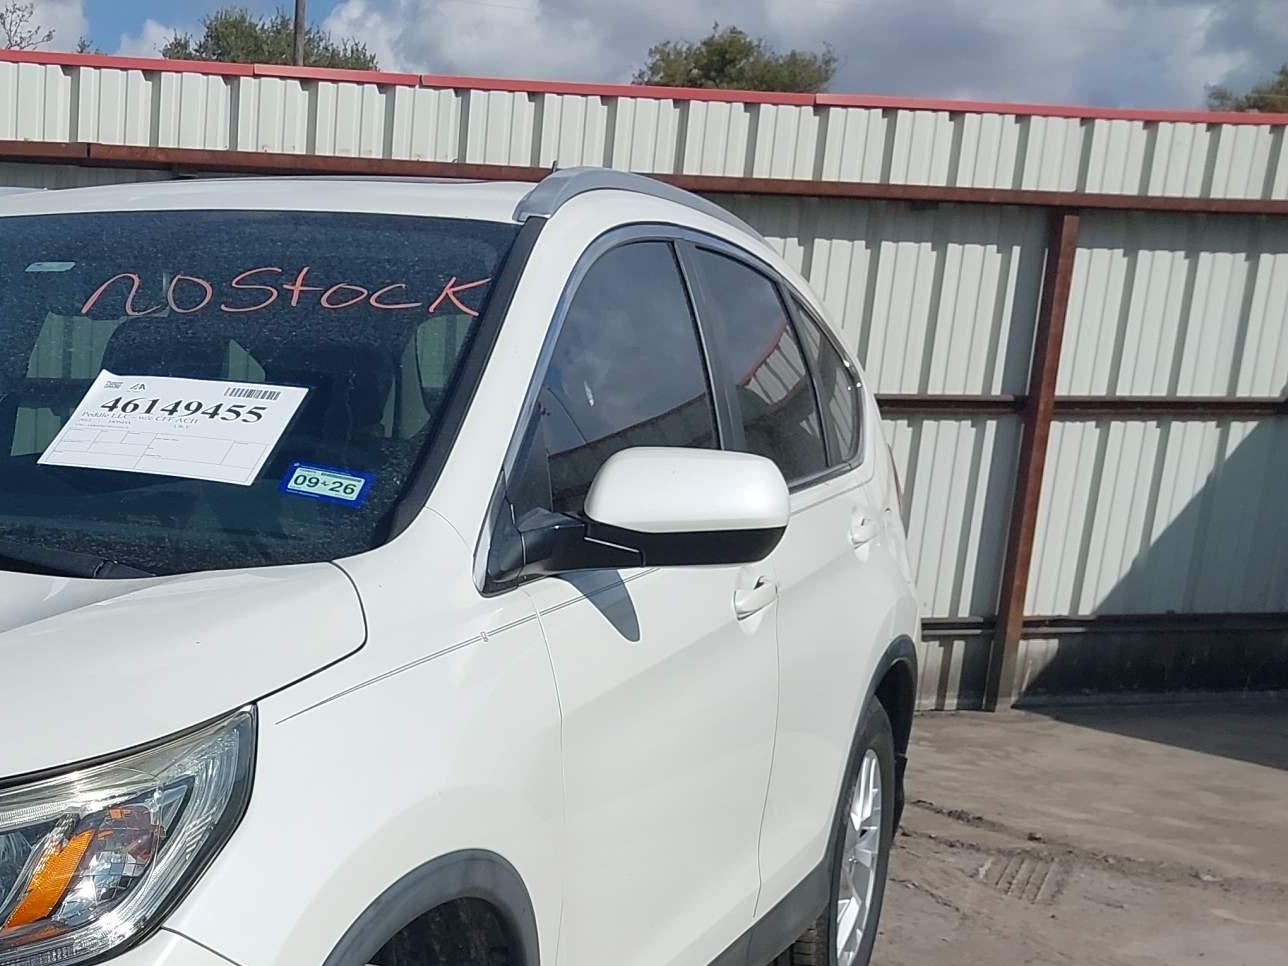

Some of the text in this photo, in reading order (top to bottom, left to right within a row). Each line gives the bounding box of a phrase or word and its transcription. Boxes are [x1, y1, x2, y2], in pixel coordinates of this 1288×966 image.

[100, 396, 268, 424] 46149455
[293, 474, 320, 488] 09
[328, 481, 358, 495] 26
